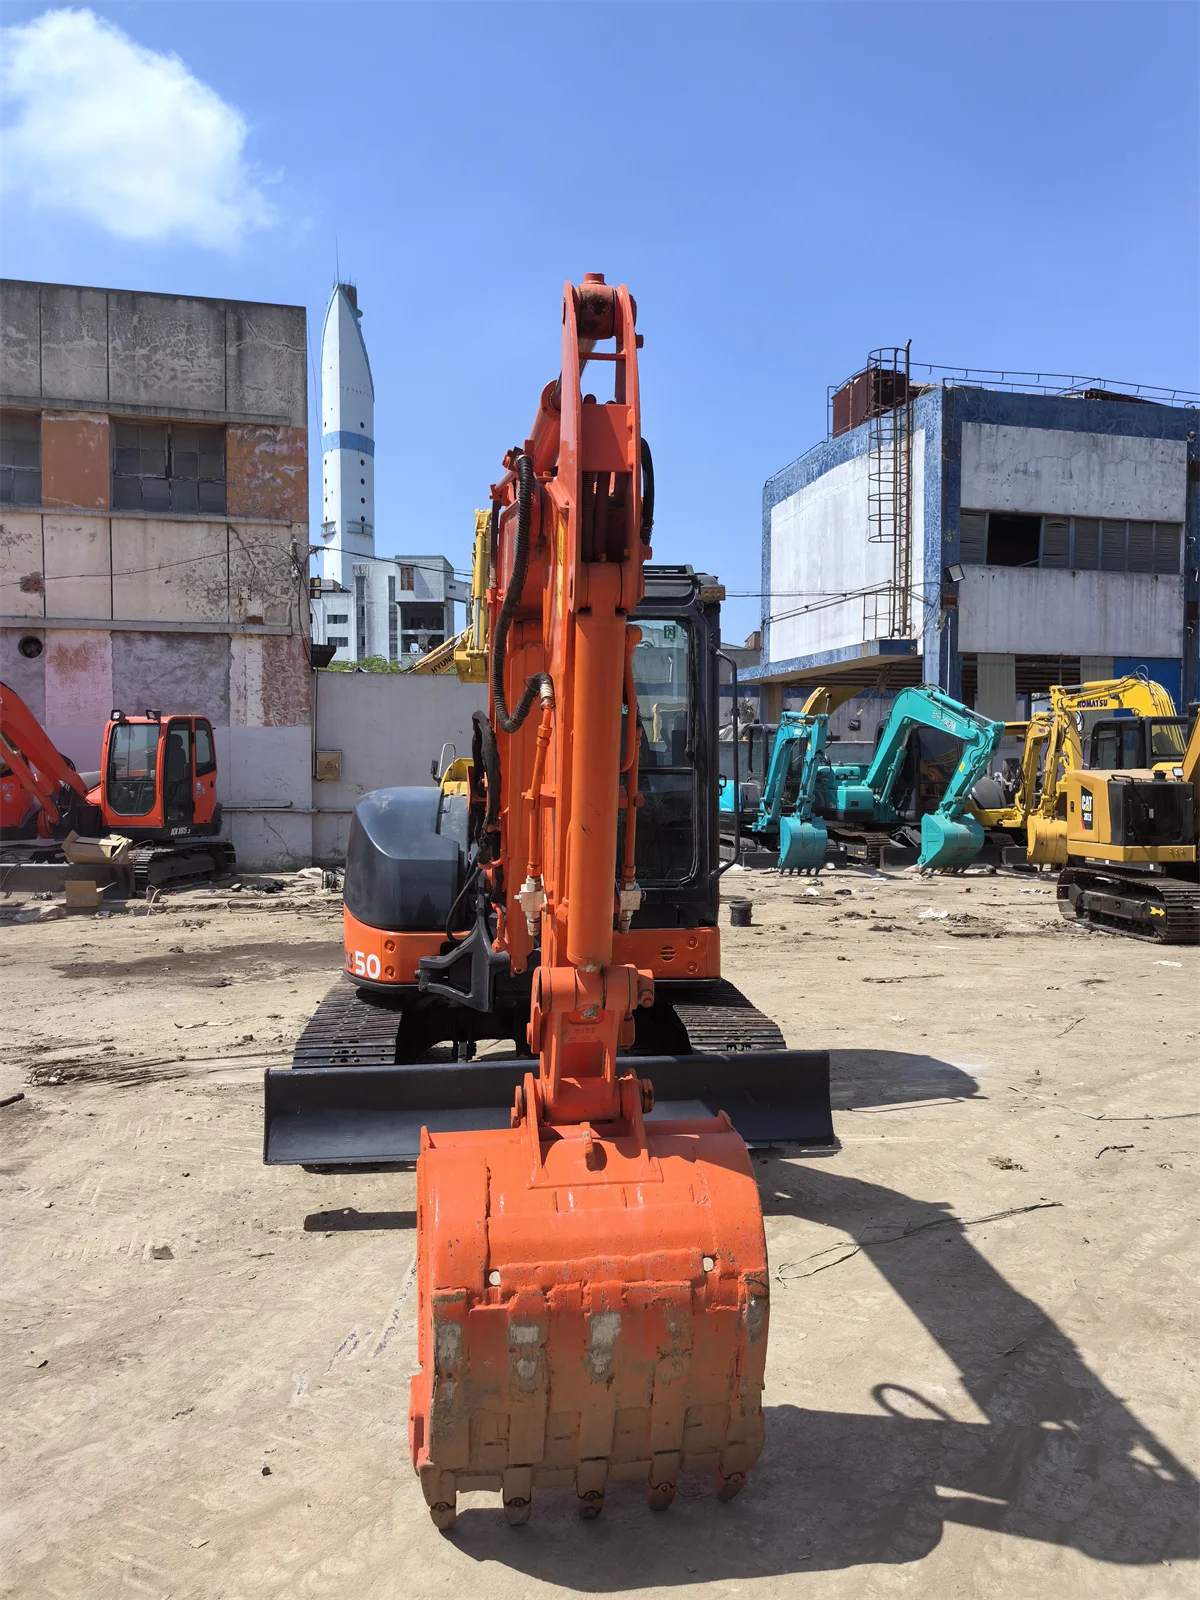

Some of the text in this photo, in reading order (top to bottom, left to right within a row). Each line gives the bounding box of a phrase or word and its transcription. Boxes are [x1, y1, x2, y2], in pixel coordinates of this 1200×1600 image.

[1077, 698, 1108, 708] KOMATSU
[1082, 795, 1092, 811] CAT
[355, 950, 381, 980] 50
